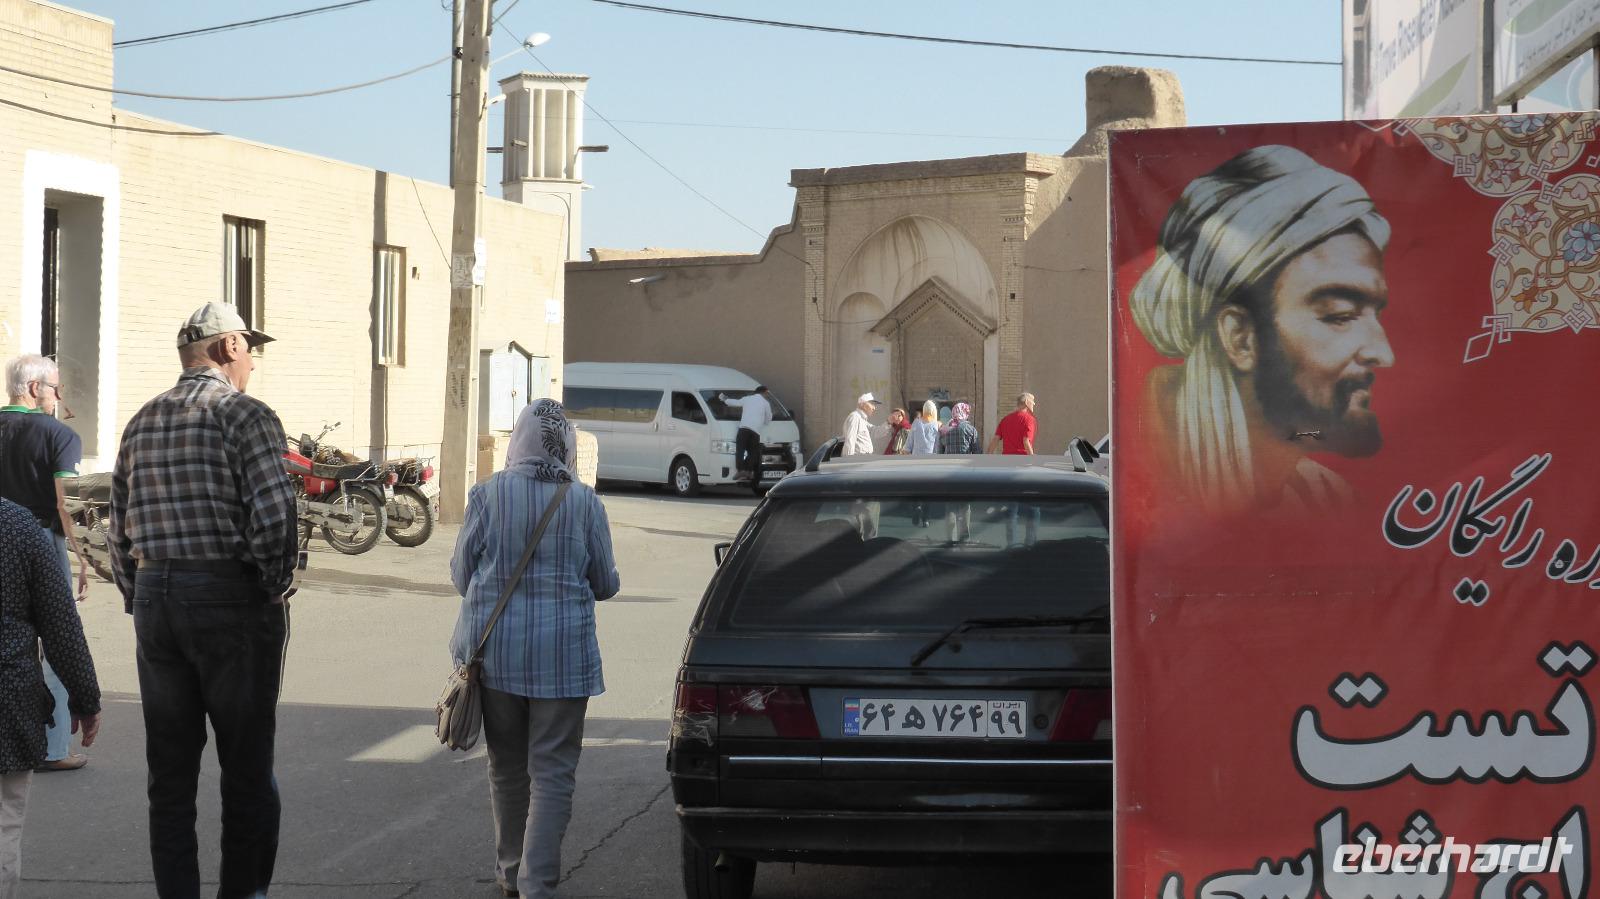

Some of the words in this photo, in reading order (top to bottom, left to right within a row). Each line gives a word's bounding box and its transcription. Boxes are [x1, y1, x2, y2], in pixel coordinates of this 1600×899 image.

[1382, 452, 1552, 607] رایگان
[990, 710, 1023, 735] ۹۹
[1290, 639, 1599, 791] تست
